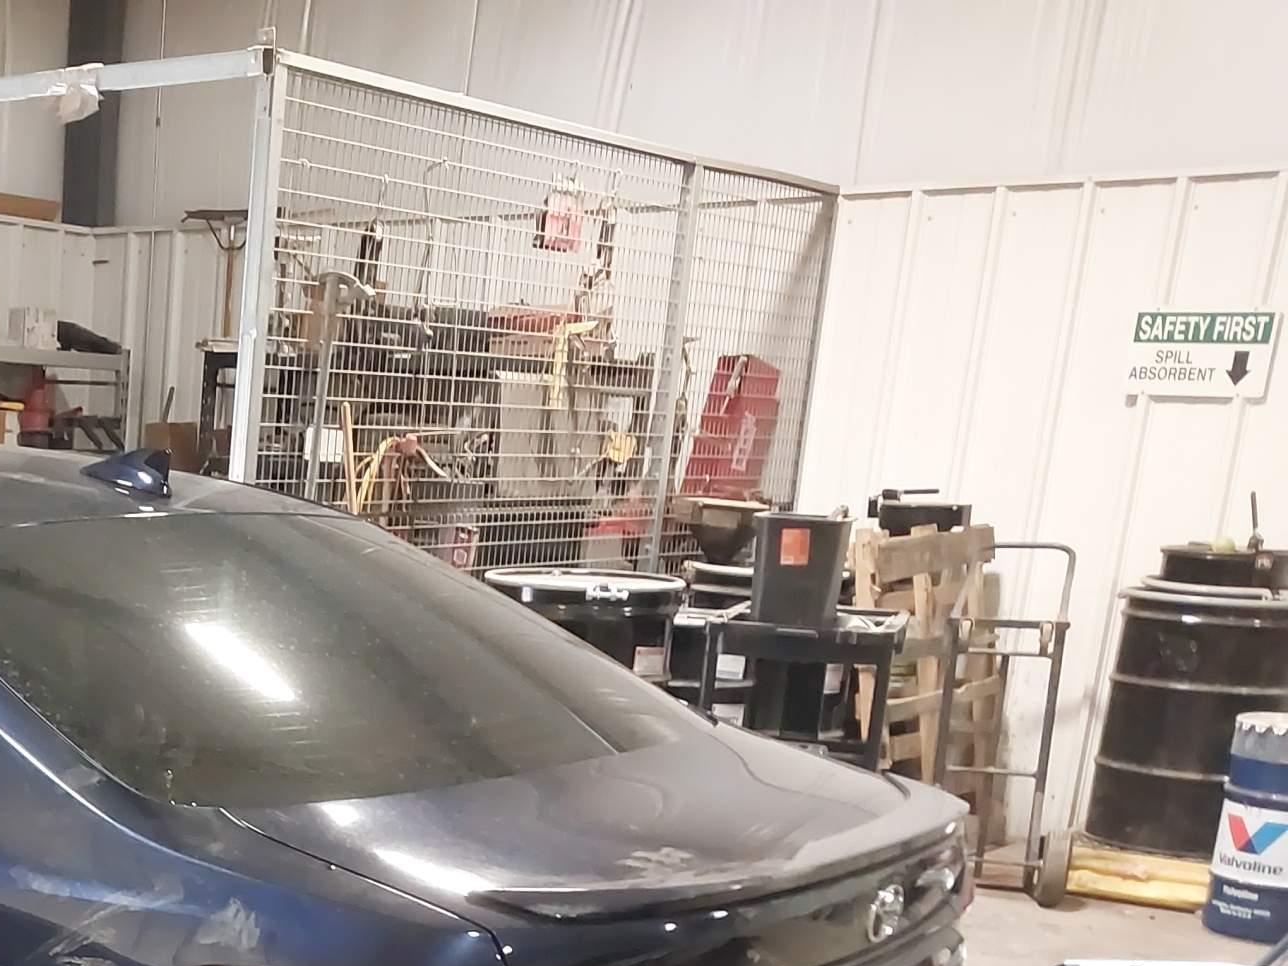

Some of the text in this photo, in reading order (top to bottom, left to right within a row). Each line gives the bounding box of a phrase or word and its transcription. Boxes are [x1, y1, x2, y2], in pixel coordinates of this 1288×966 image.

[1138, 315, 1270, 342] SAFETY FIRST
[1155, 350, 1193, 364] SPILL
[1128, 366, 1216, 382] ABSORBENT
[1218, 851, 1284, 876] Valvoline
